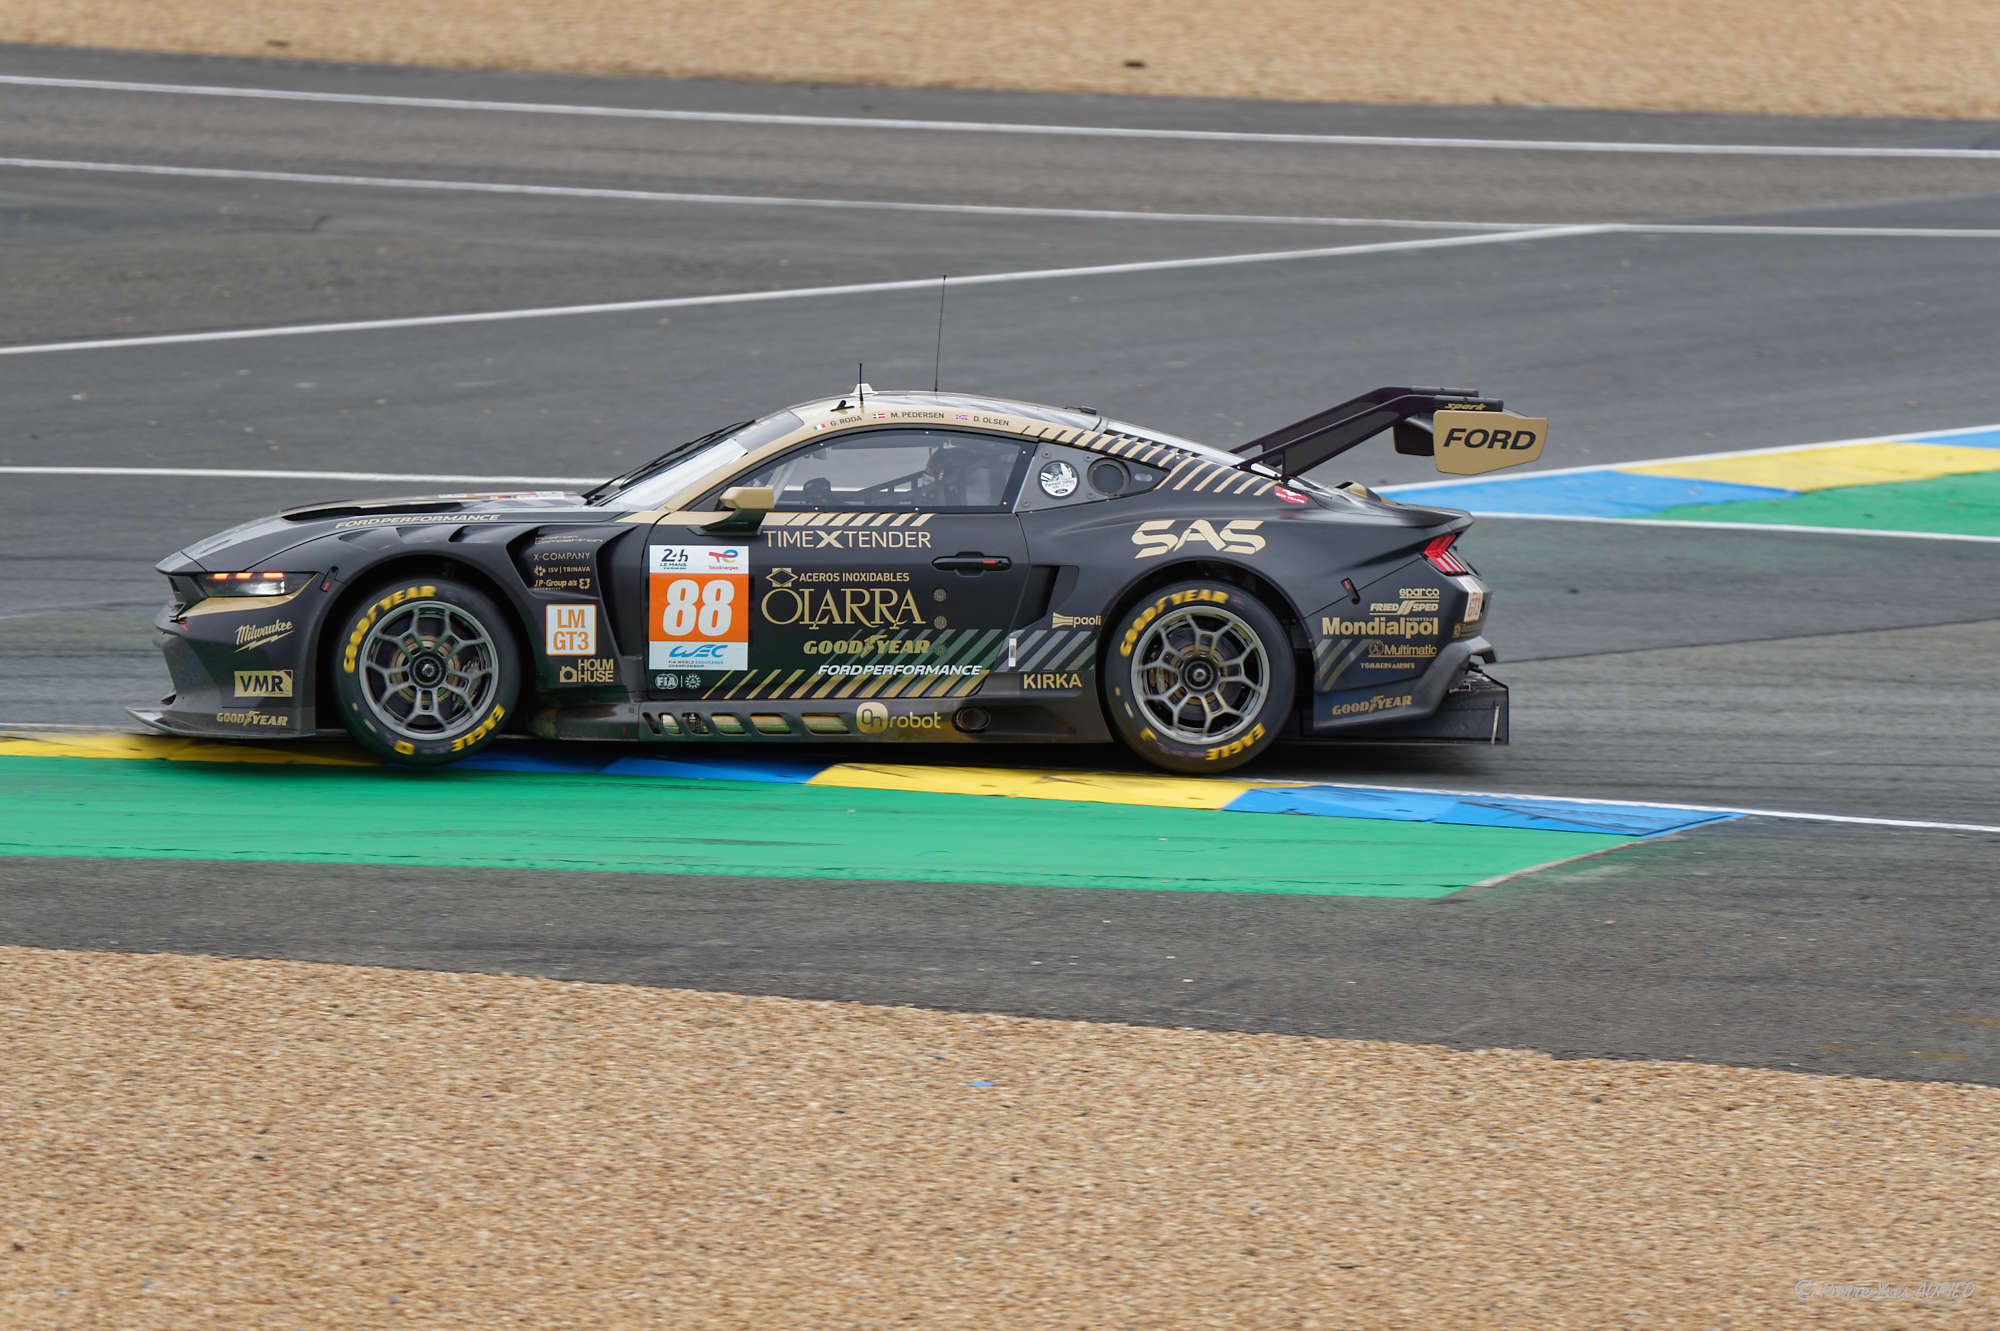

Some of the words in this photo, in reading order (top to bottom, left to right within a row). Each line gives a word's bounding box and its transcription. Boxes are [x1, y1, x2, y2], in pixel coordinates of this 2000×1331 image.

[902, 411, 945, 420] PEDERSEN
[983, 417, 1010, 427] OLSEN
[1443, 427, 1537, 451] FORD
[762, 530, 932, 549] TIMEXTENDER
[1131, 519, 1267, 559] SAS
[799, 573, 840, 582] ACEROS
[842, 573, 910, 582] INOXIDABLES
[1399, 587, 1440, 599] sparco
[662, 579, 735, 636] 88
[557, 609, 585, 628] LM
[1073, 615, 1102, 628] paoli
[235, 619, 293, 645] Milwaukee
[1322, 617, 1439, 639] Mondialpol
[553, 631, 589, 650] GT3
[803, 635, 931, 658] GOODYEAR
[669, 644, 728, 657] WEC
[1384, 644, 1437, 655] Multimatic
[577, 658, 614, 671] HOLM
[240, 675, 284, 692] VMR
[577, 670, 614, 683] HUSE
[1023, 673, 1083, 689] KIRKA
[1331, 695, 1413, 715] GOODYEAR
[216, 711, 288, 726] GOODYEAR
